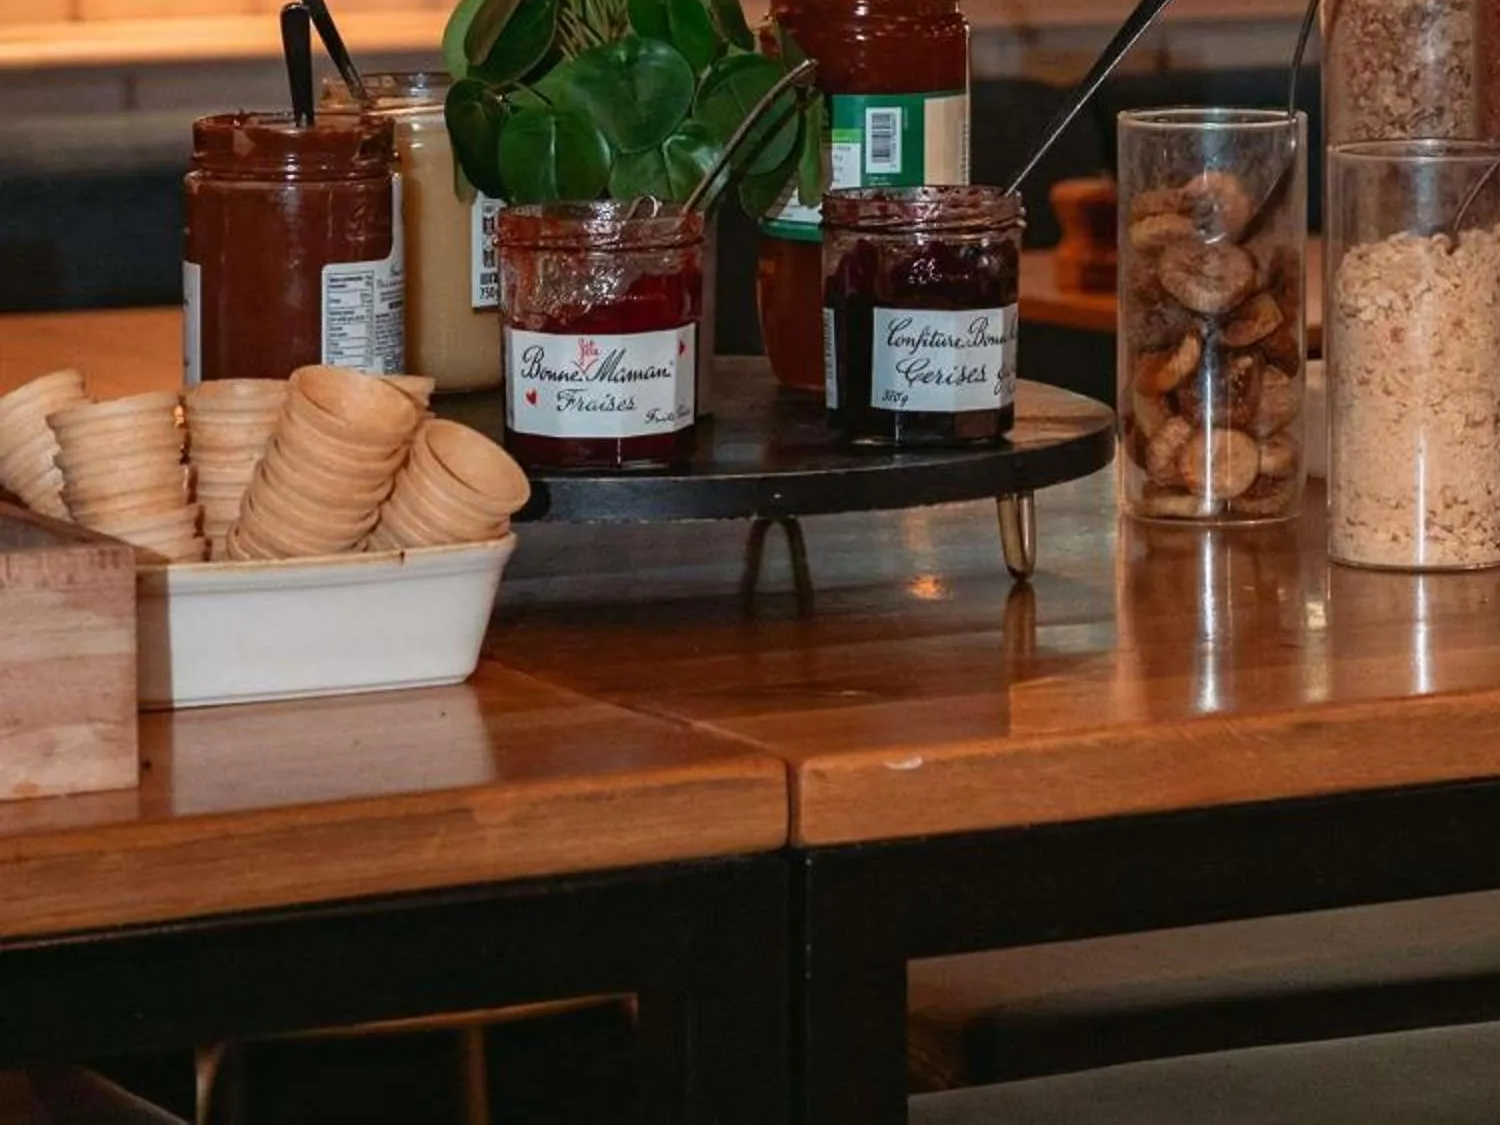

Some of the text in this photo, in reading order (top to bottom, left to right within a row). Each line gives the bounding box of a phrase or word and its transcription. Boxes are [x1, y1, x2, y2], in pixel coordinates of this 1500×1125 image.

[886, 317, 966, 355] Confiture
[521, 345, 674, 383] Bonne Maman
[895, 357, 988, 388] Cerises
[556, 388, 637, 413] Fraises
